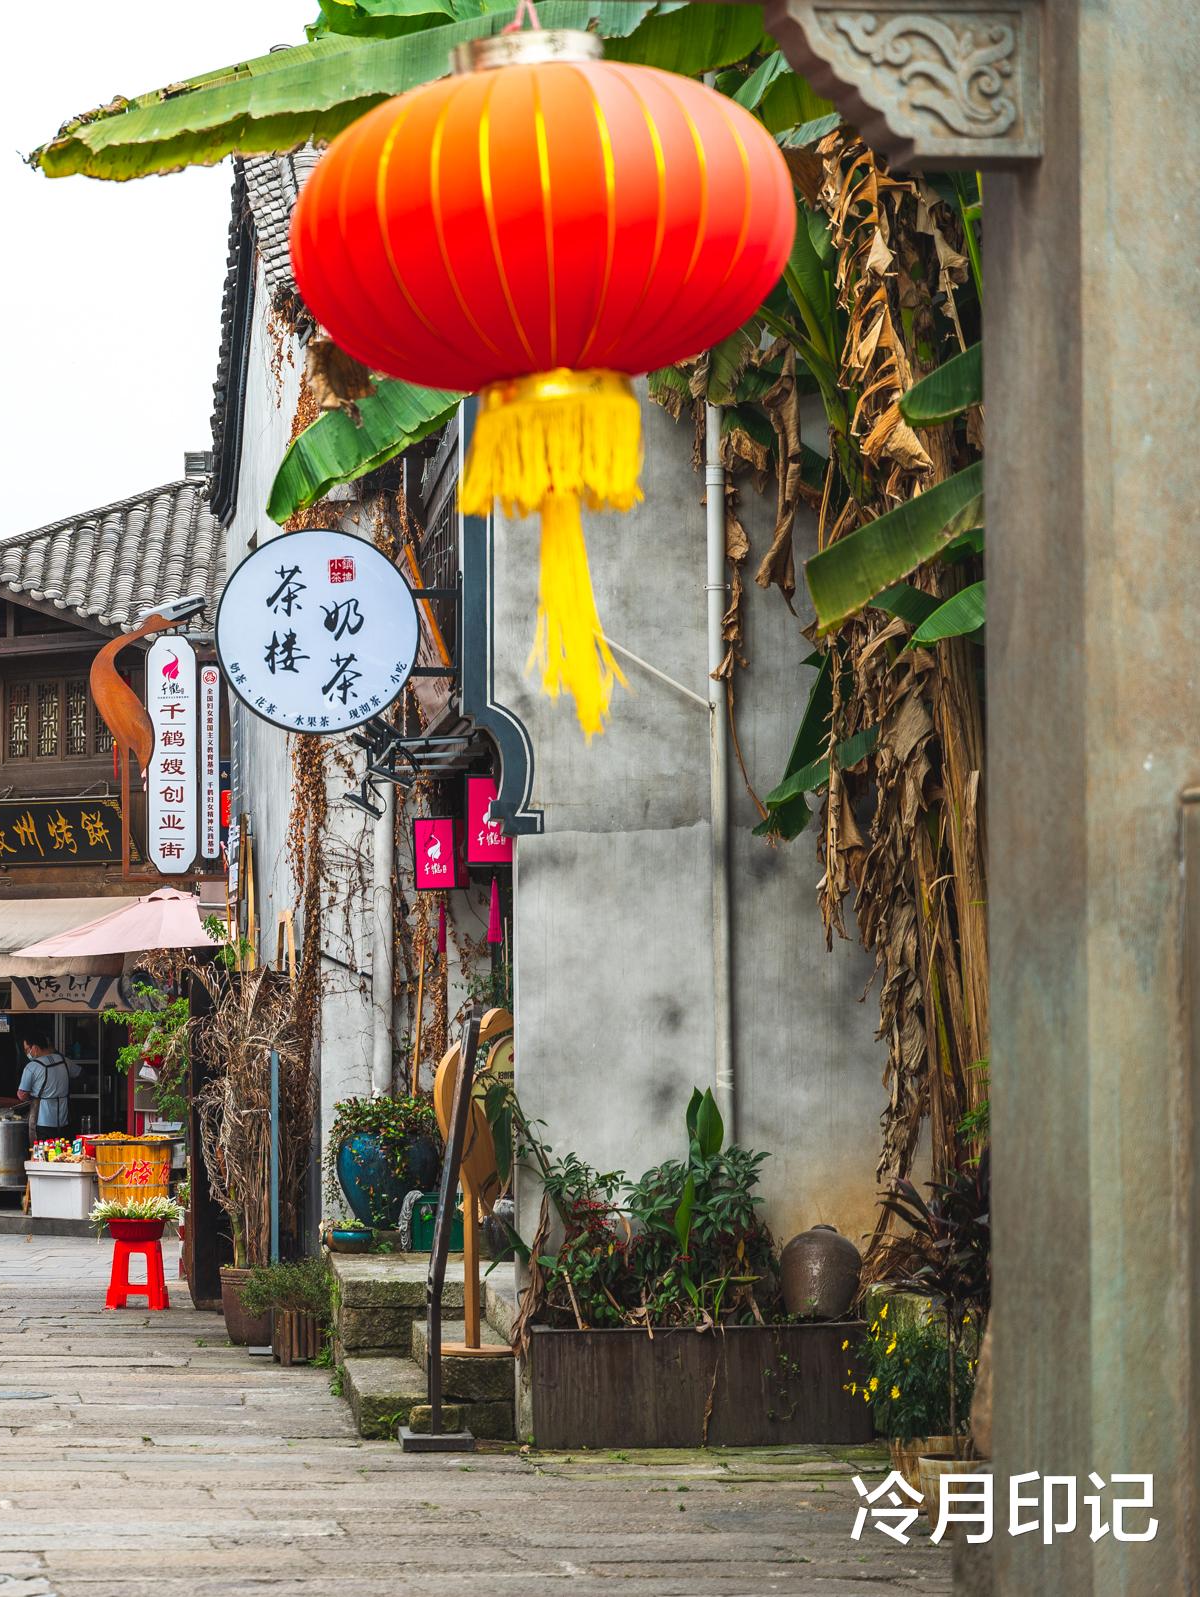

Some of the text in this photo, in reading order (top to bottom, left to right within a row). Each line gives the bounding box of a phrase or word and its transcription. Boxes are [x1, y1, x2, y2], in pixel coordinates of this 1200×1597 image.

[263, 564, 311, 675] 茶楼
[319, 598, 365, 706] 奶茶
[159, 703, 186, 859] 千鹤嫂创业街
